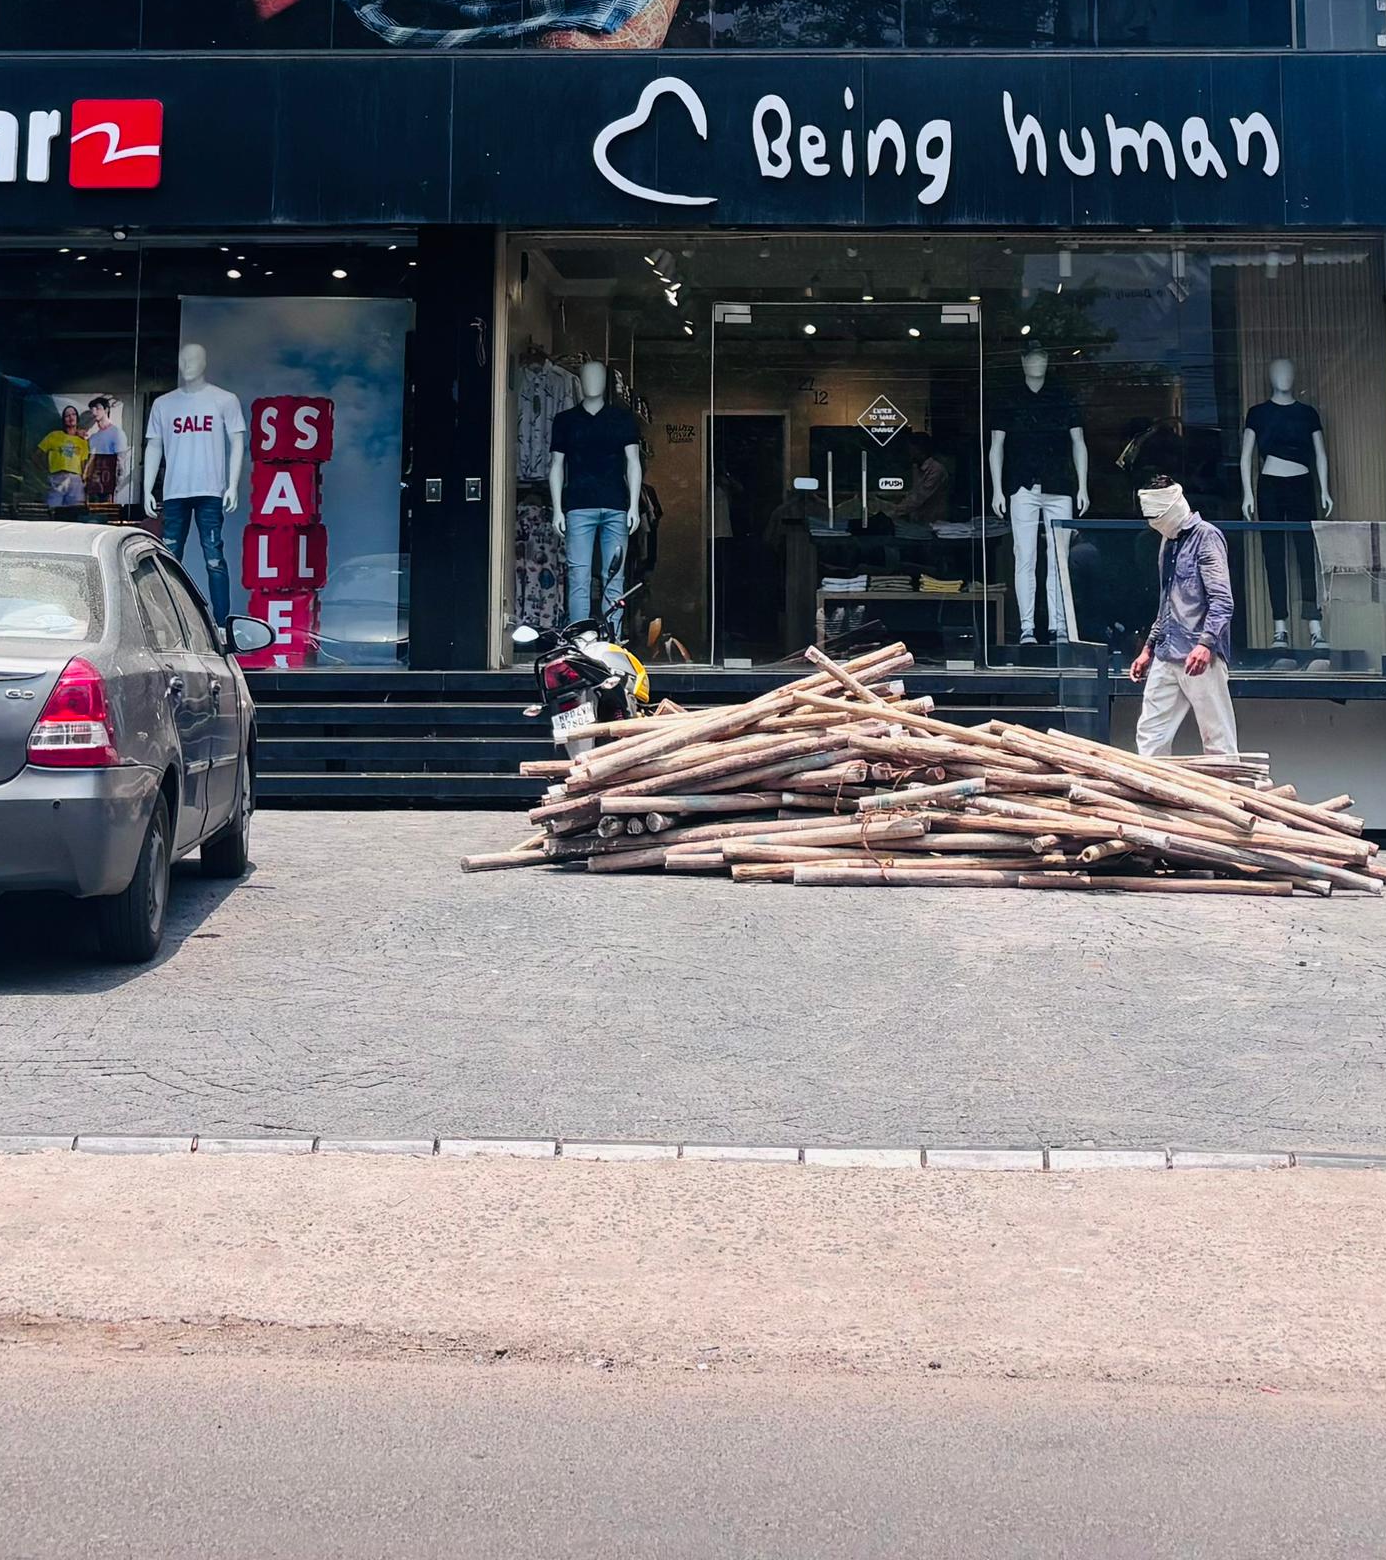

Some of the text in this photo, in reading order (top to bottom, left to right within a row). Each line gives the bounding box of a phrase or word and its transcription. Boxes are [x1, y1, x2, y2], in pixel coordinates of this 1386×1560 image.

[751, 86, 1281, 206] Being human
[172, 415, 214, 434] SALE
